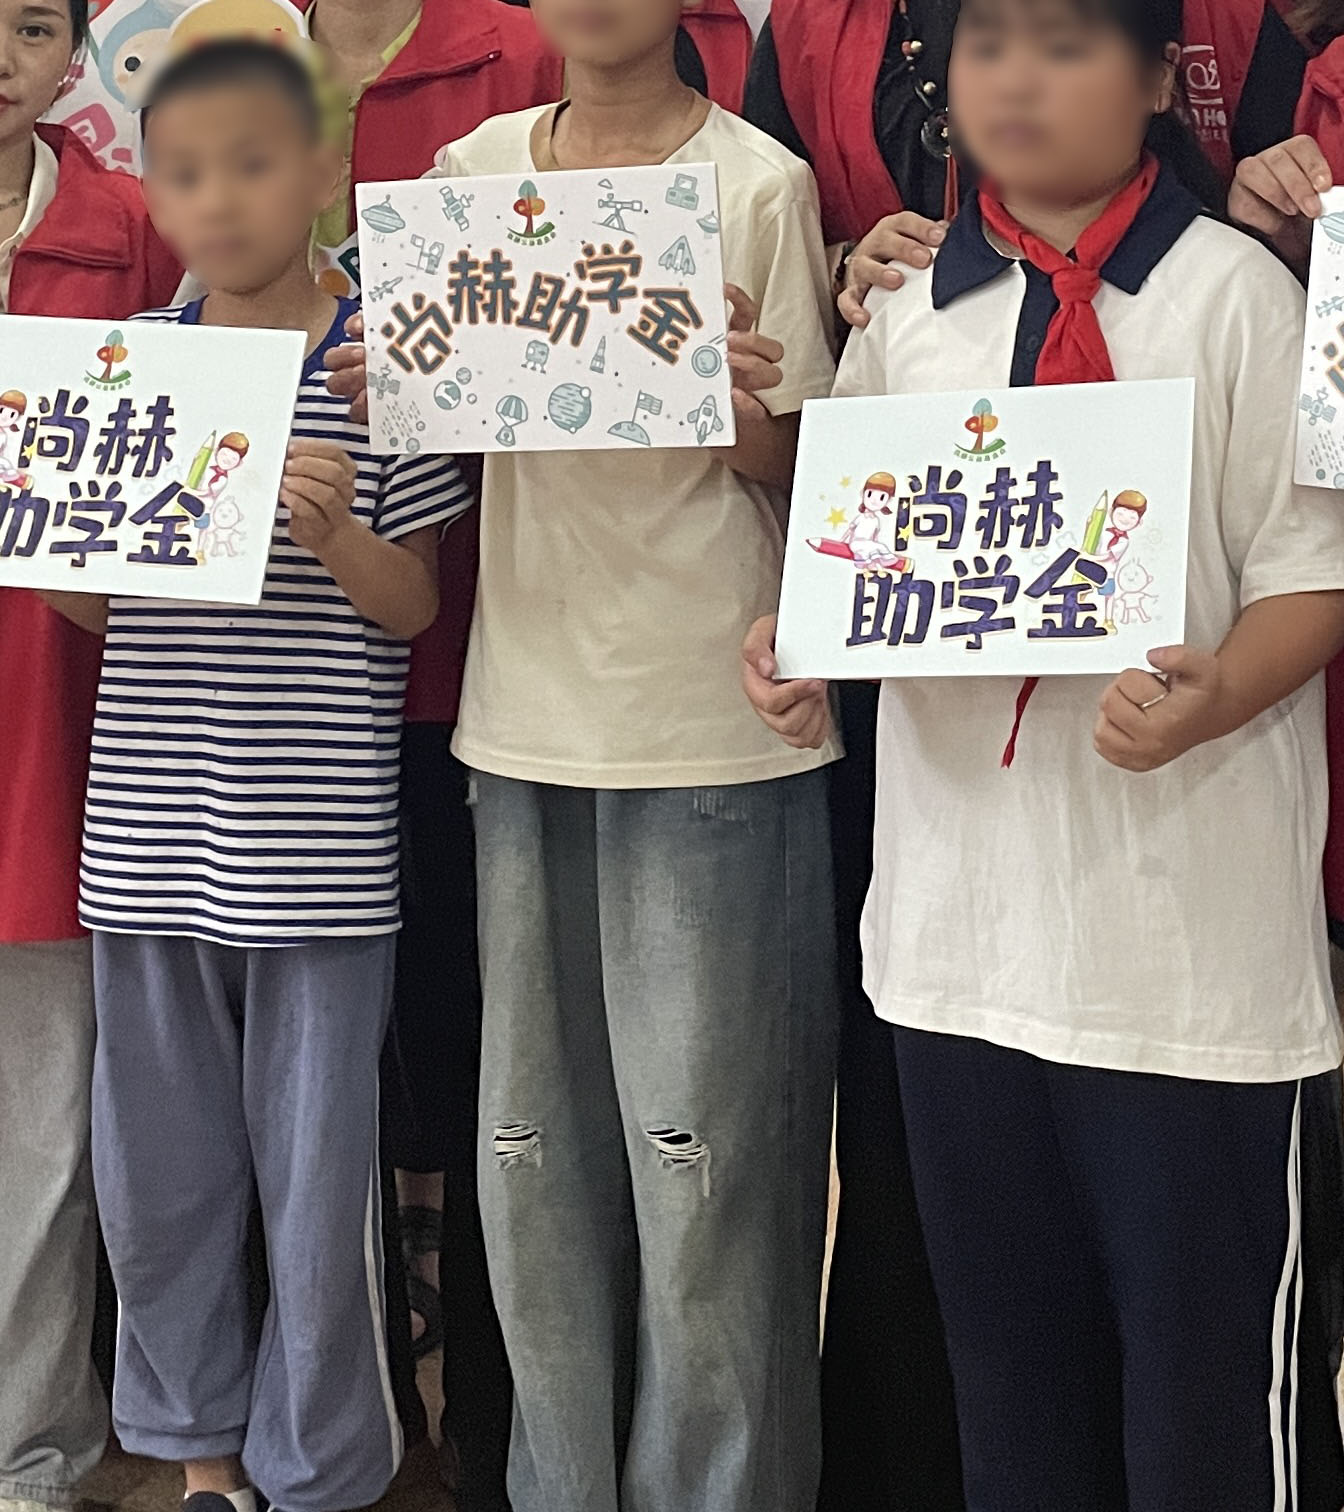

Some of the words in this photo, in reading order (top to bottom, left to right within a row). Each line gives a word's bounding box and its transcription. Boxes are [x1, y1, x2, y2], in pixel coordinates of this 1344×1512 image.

[381, 239, 705, 376] 尚赫助学金
[17, 389, 177, 478] 尚赫
[894, 459, 1066, 553] 尚赫
[845, 547, 1111, 652] 助学金
